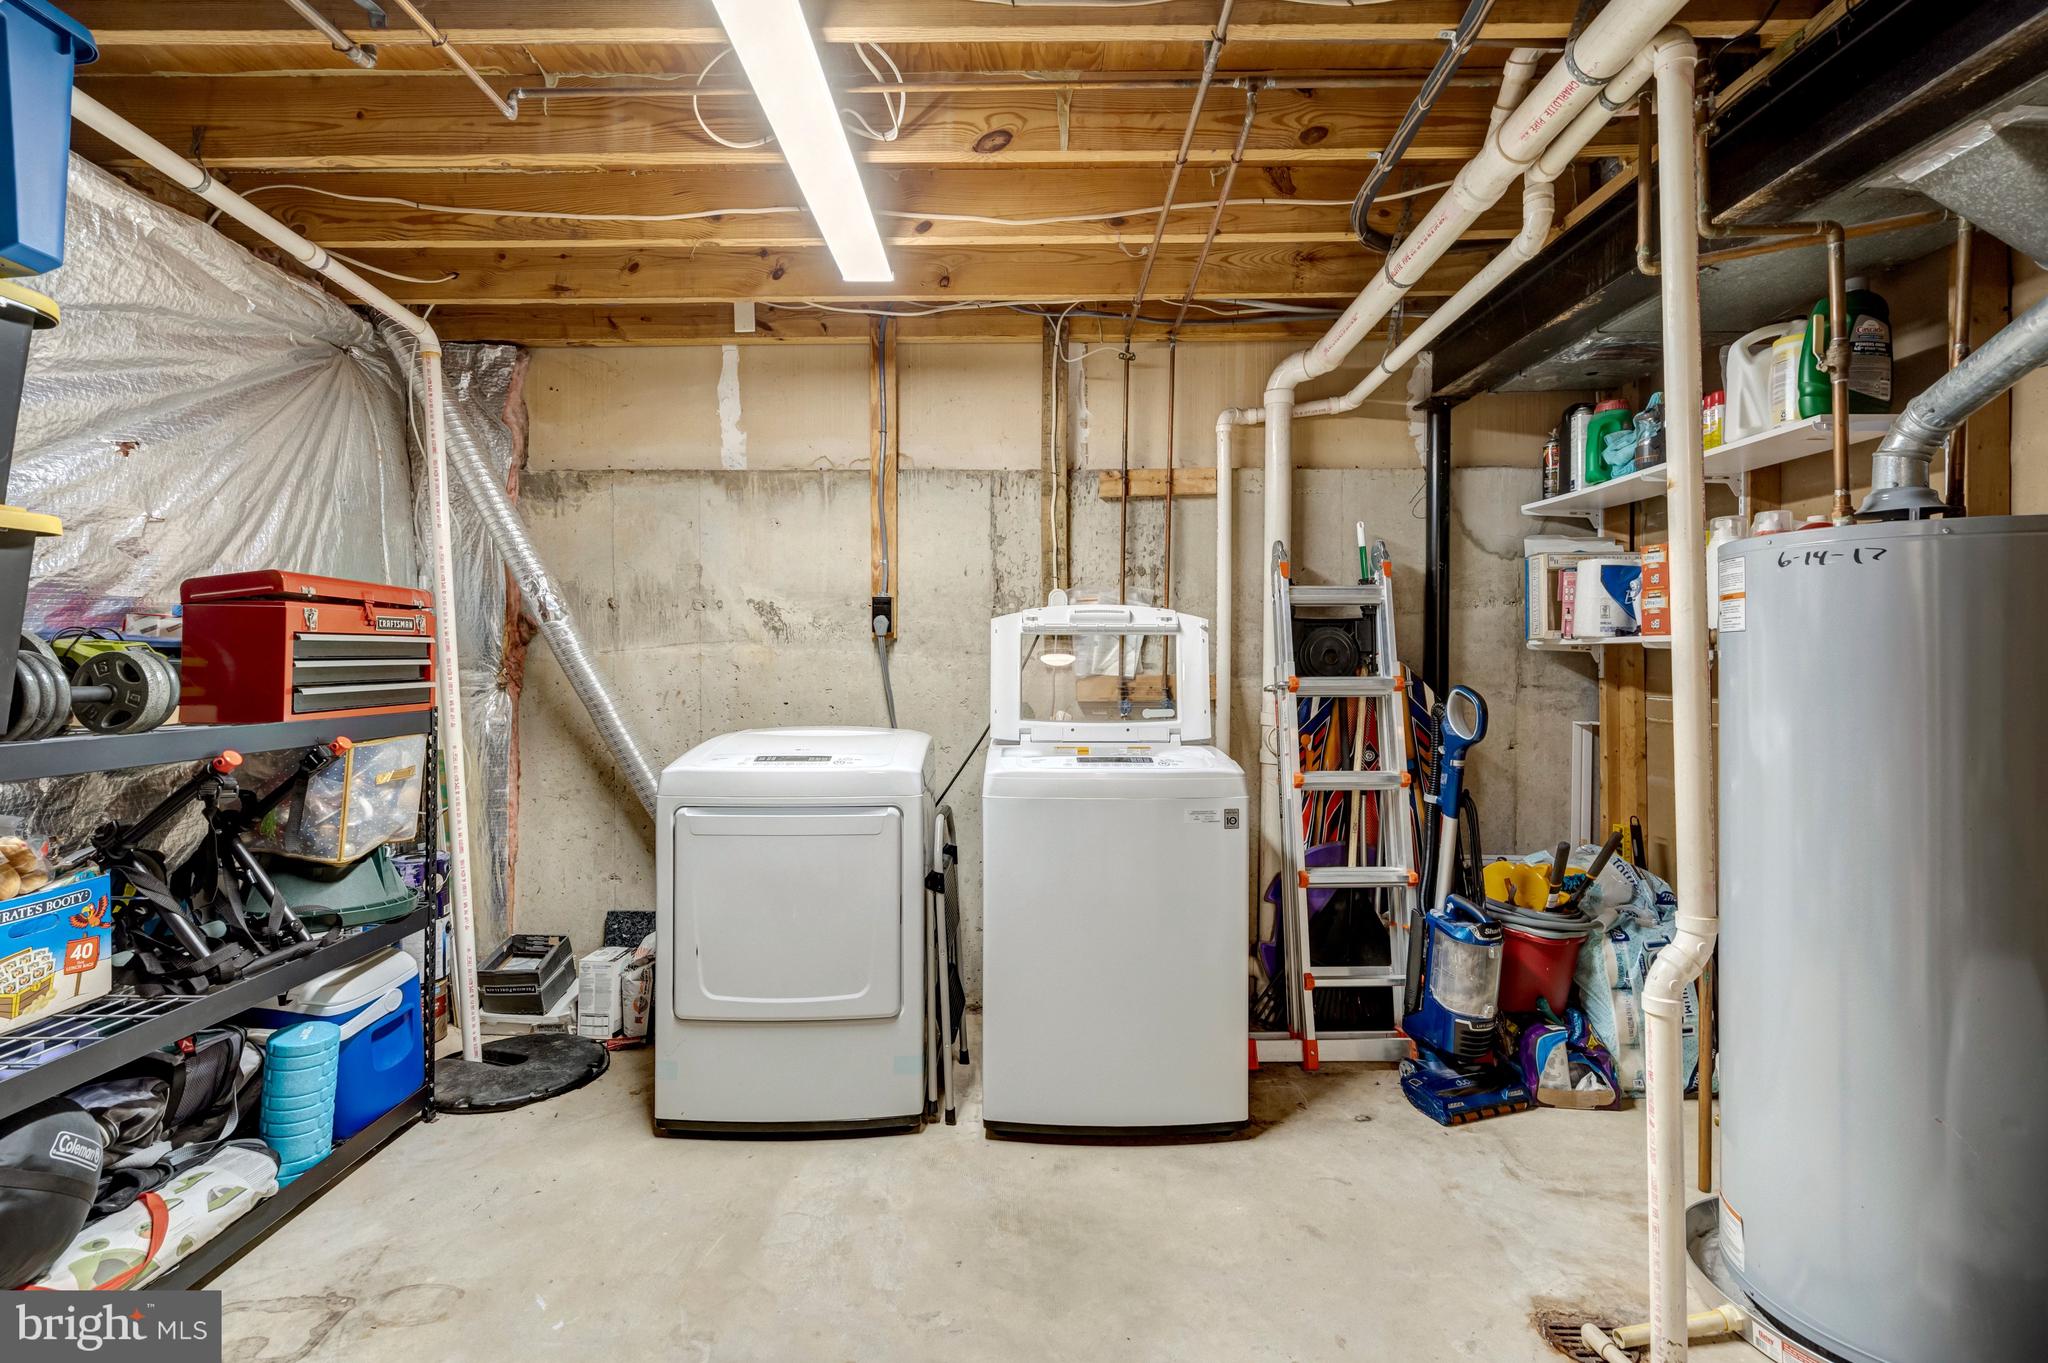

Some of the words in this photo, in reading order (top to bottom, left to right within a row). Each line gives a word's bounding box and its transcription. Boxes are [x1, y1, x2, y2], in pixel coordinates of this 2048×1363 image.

[1529, 117, 1546, 133] PIPE
[379, 619, 413, 629] CRAFTSMAN
[1, 904, 43, 923] RATE'S
[46, 891, 84, 912] BOOTY
[70, 942, 94, 961] 40
